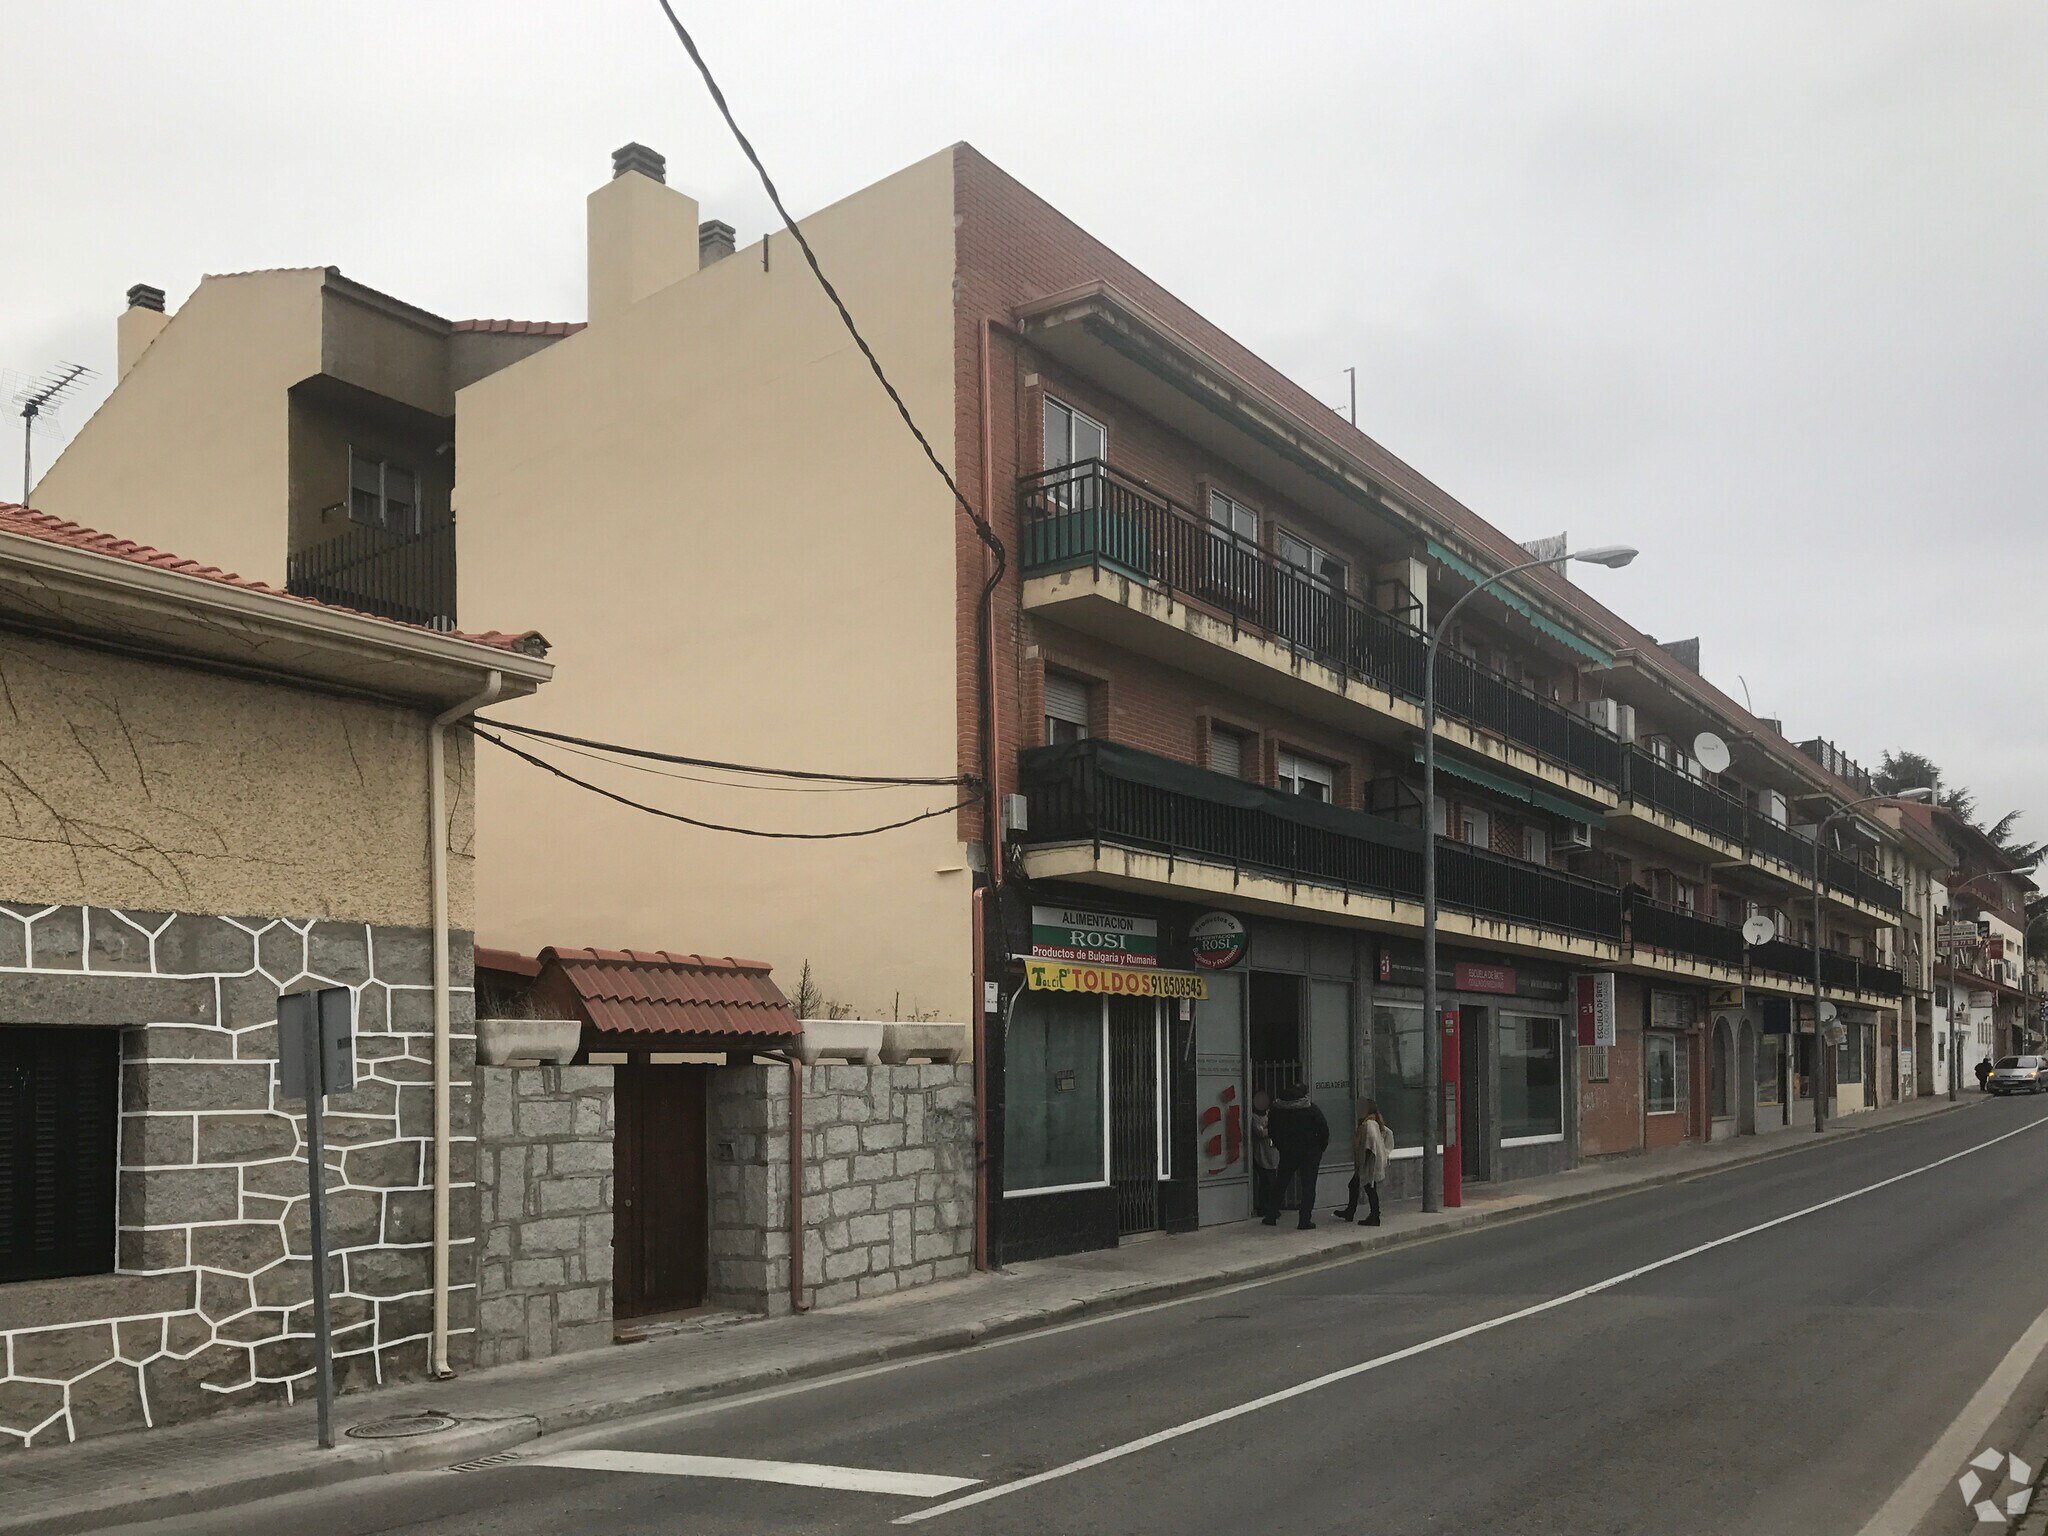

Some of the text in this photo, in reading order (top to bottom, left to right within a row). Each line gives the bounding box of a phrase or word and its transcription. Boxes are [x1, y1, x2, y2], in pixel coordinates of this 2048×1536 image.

[1062, 912, 1133, 931] ALIMENTACION
[1195, 916, 1228, 932] Productos
[1070, 930, 1126, 949] ROSI
[1202, 939, 1231, 950] ROSI
[1032, 945, 1157, 966] Productos de Bulgaria y Rumania
[1072, 969, 1150, 994] TOLDOS
